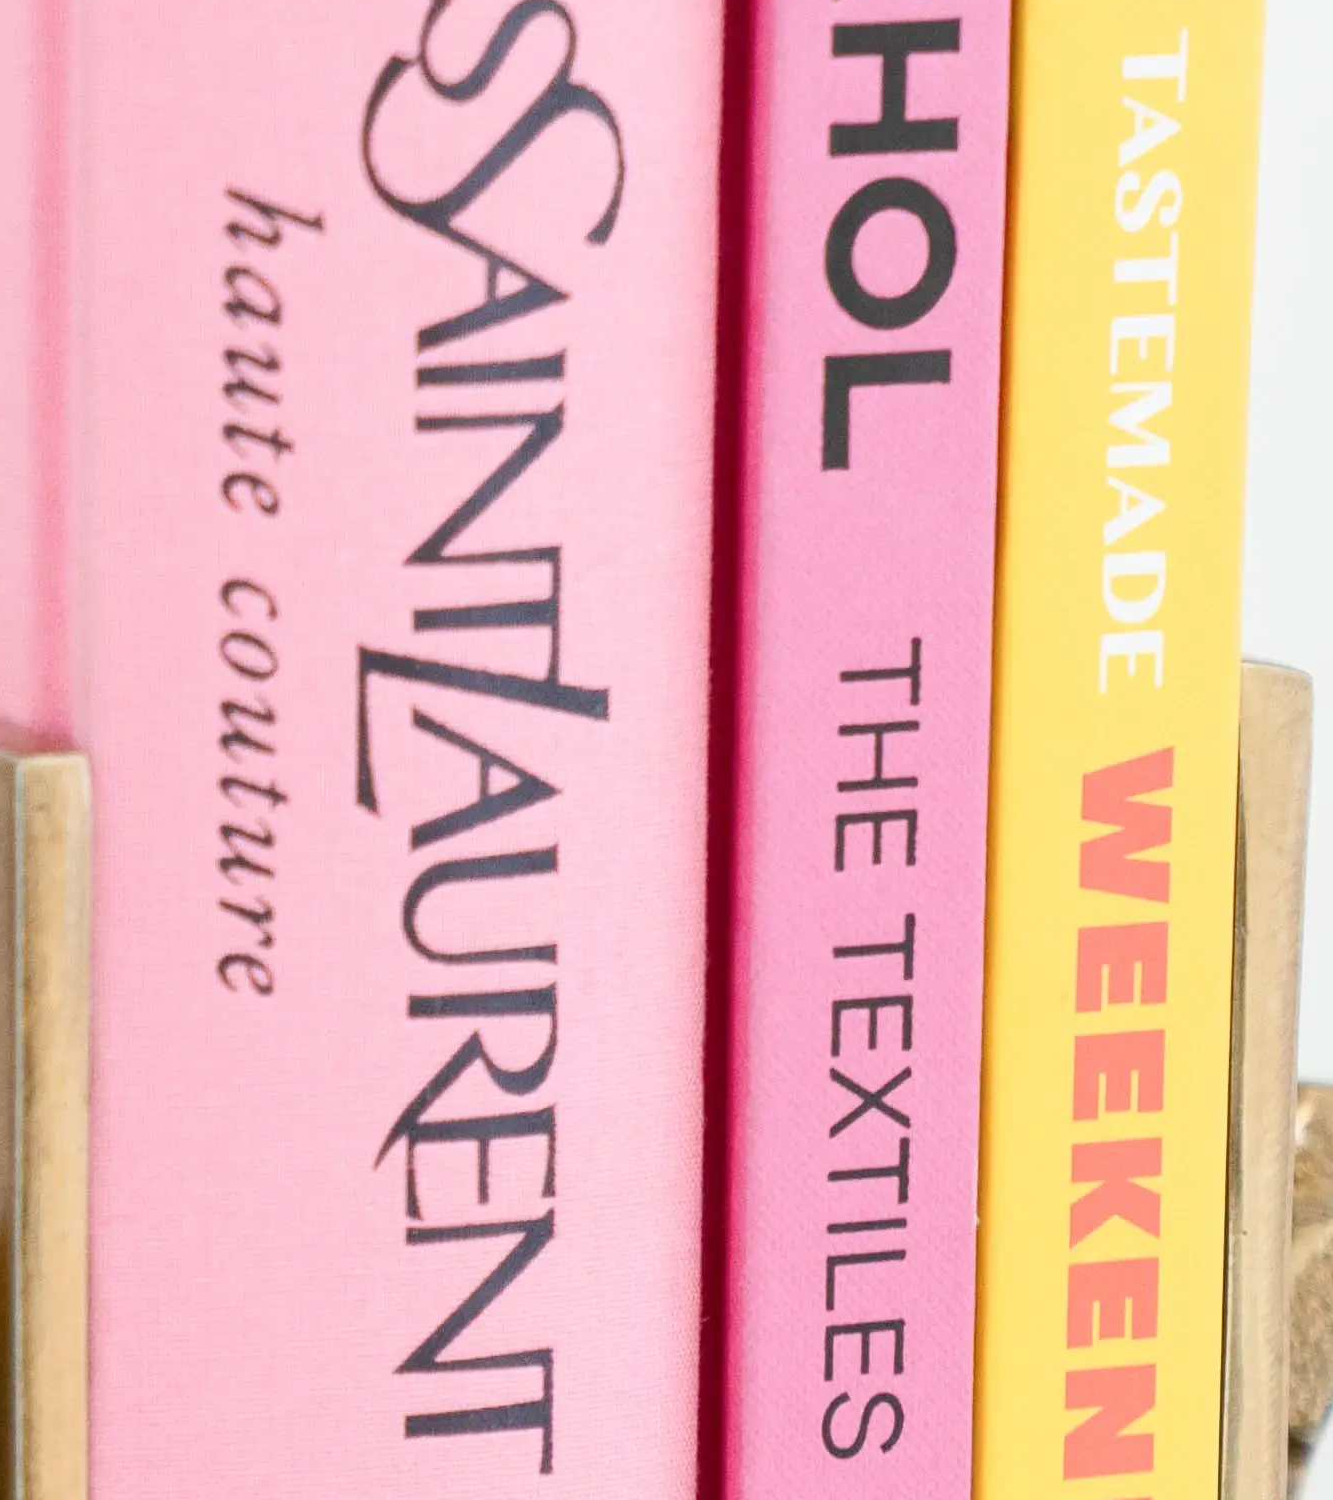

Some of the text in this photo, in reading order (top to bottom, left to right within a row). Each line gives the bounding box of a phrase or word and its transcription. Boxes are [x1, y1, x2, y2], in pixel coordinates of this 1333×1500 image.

[217, 188, 325, 1000] haute couture
[1097, 25, 1191, 696] TASTEMADE
[820, 636, 923, 1462] THE TEXTILES
